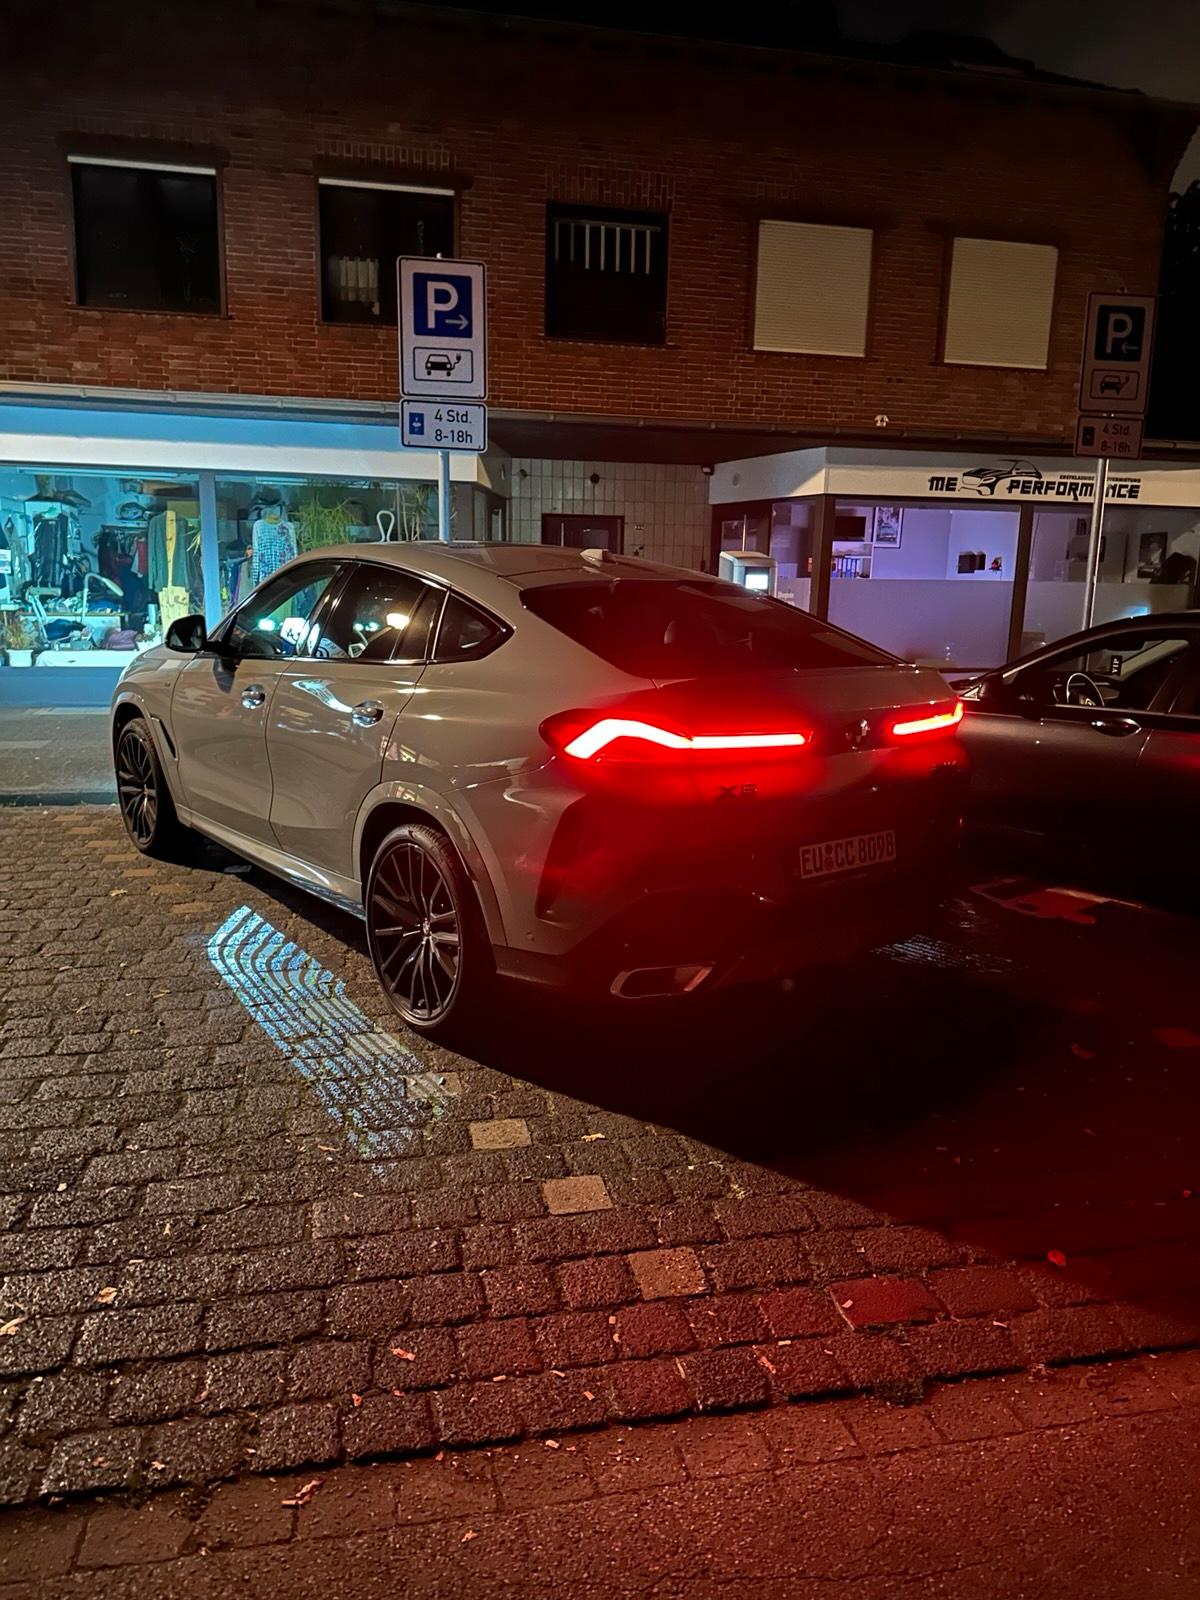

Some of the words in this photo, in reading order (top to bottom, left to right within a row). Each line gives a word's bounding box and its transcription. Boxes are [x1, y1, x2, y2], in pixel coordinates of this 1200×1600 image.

[427, 281, 459, 329] P
[1106, 313, 1133, 354] P
[434, 409, 443, 422] 4
[446, 409, 472, 424] Std.
[1102, 423, 1109, 434] 4
[434, 429, 473, 444] 8-18h
[1100, 440, 1131, 453] 8-18h
[928, 476, 958, 492] ME
[1007, 480, 1141, 501] PERFORMNCE
[1111, 658, 1119, 673] VIP
[801, 847, 823, 875] EU
[834, 840, 855, 868] CC
[858, 832, 894, 863] 8098
